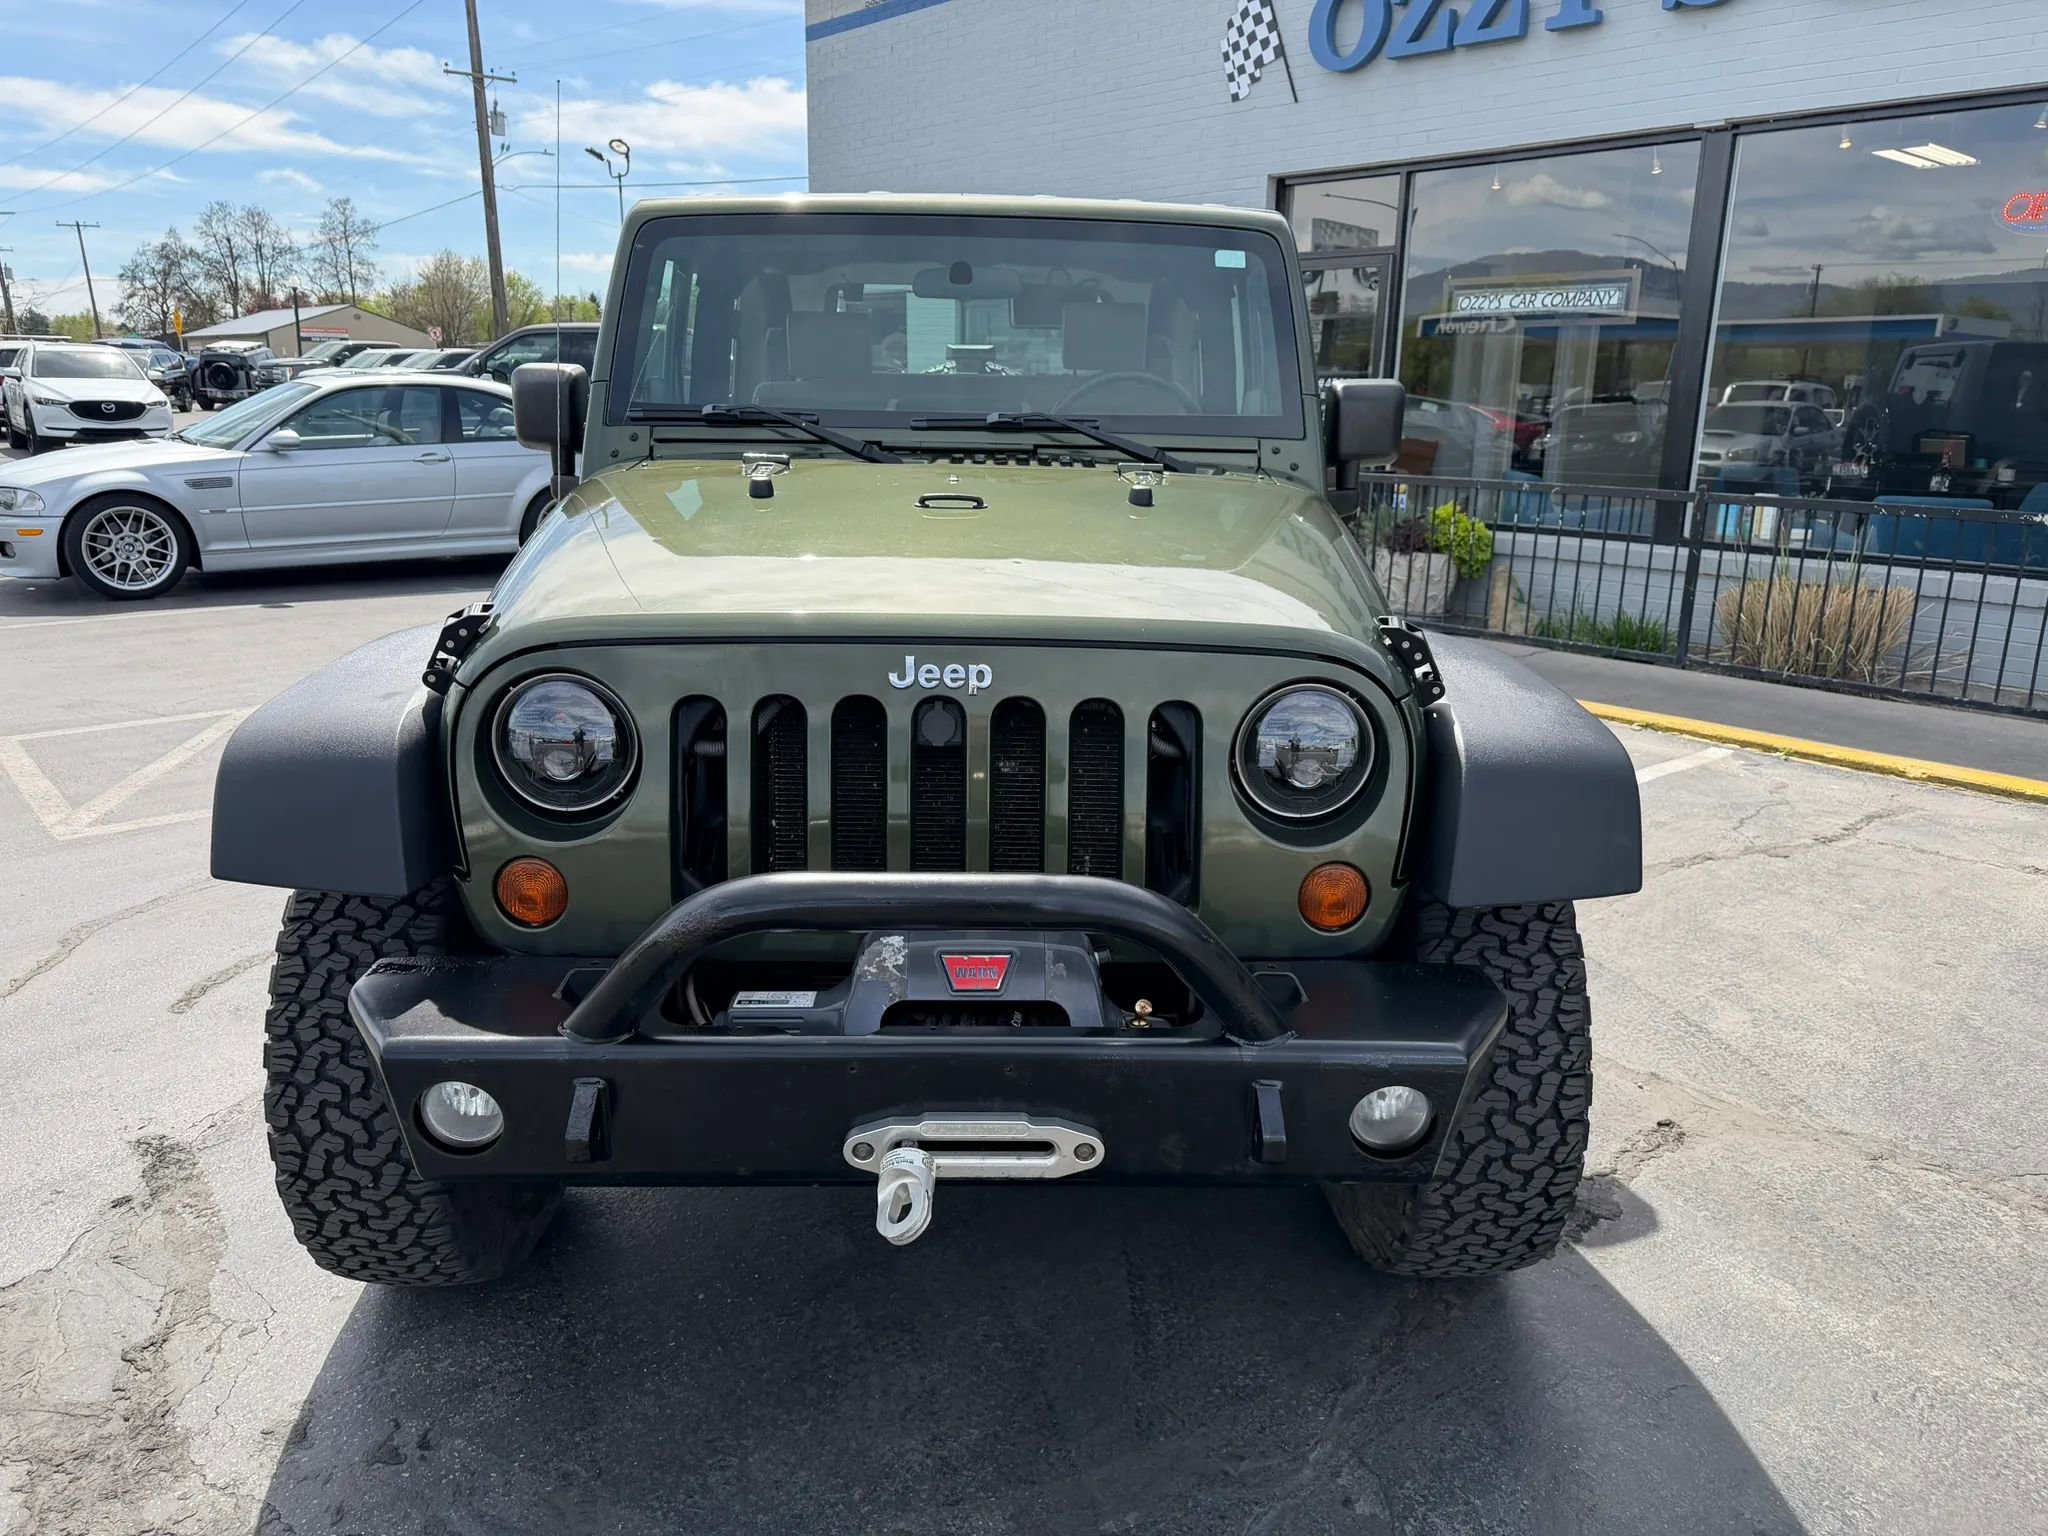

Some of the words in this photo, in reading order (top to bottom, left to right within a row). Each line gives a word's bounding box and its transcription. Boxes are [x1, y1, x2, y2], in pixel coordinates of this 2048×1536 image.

[1308, 0, 1726, 73] OZZ
[1460, 295, 1504, 310] OZZY'S
[1510, 293, 1537, 308] CAR
[1541, 290, 1618, 307] COMPANY
[888, 655, 993, 696] Jeep
[954, 966, 998, 979] WARN
